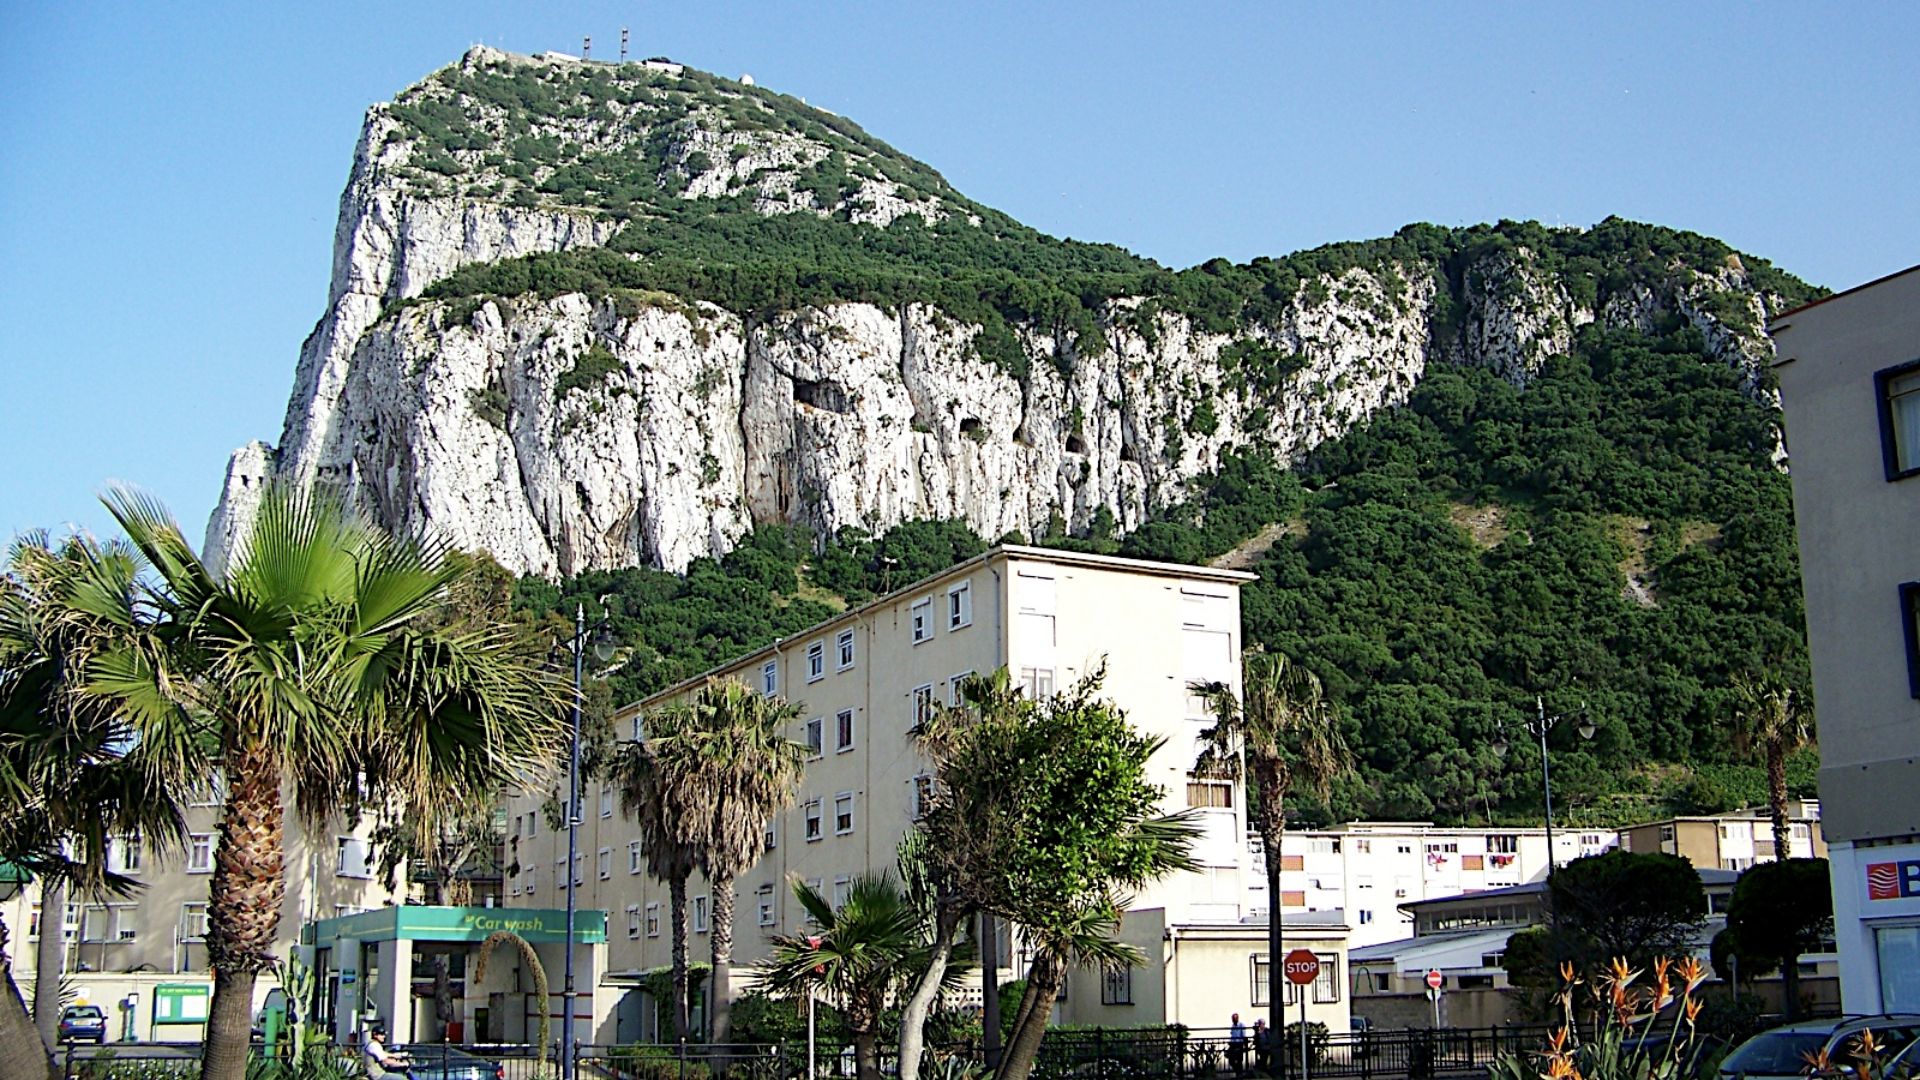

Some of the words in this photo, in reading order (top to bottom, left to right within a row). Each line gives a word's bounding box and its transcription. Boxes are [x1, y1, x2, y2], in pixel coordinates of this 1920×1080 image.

[474, 915, 502, 930] Car
[504, 917, 543, 931] wash
[1286, 961, 1317, 974] STOP
